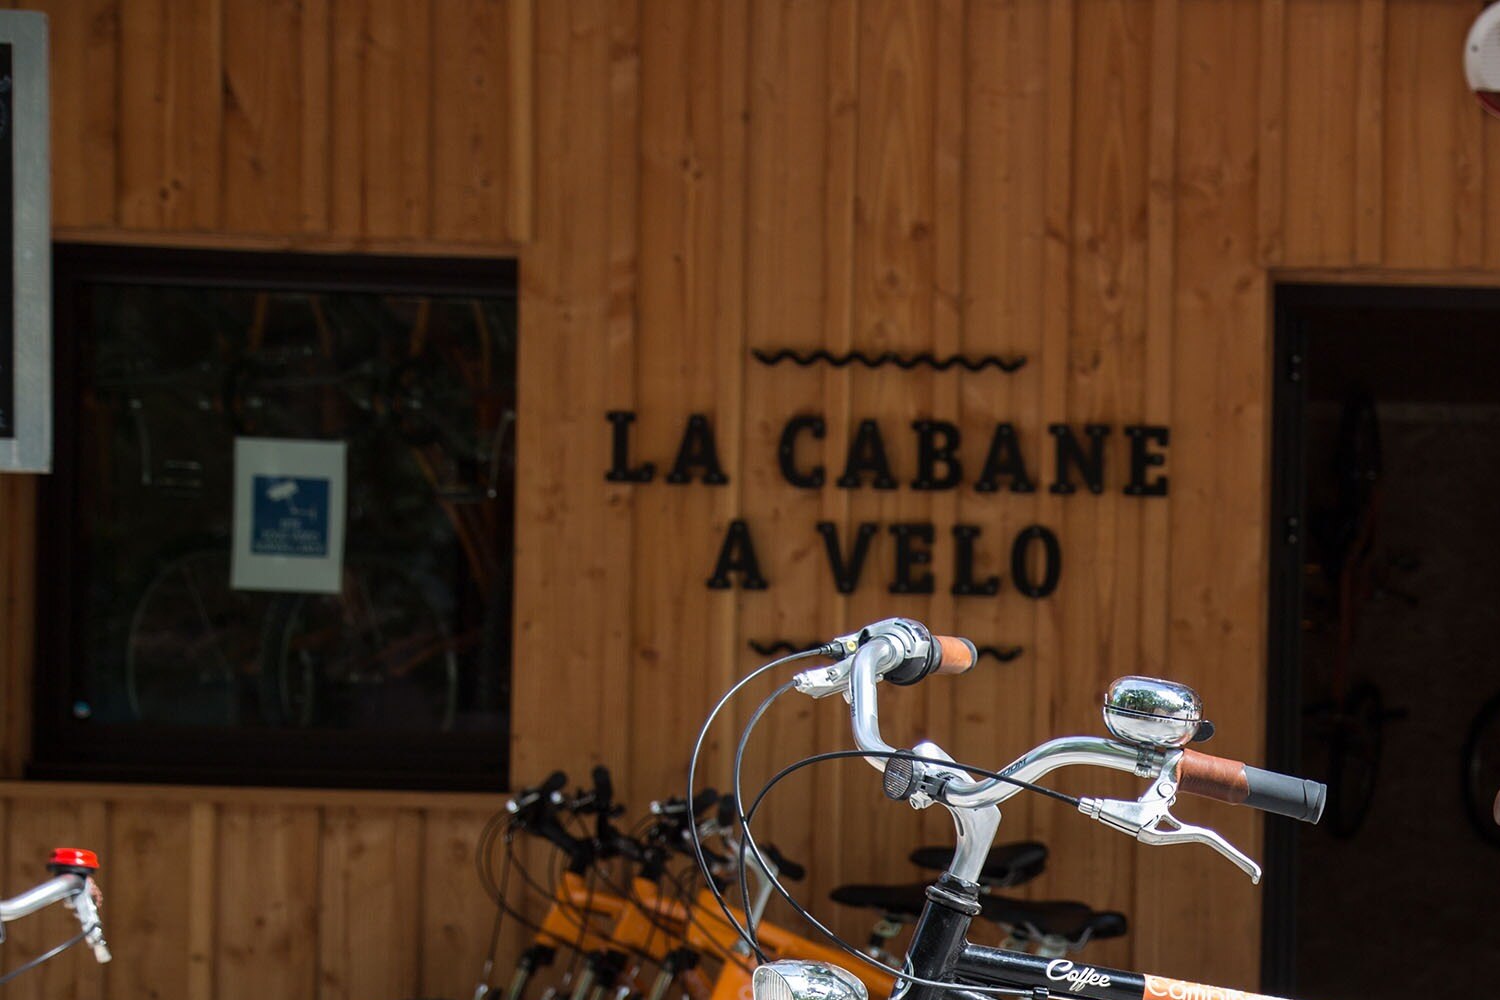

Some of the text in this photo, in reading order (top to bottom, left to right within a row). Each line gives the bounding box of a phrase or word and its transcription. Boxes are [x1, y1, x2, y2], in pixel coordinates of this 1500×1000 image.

[605, 411, 1170, 497] LA CABANE
[706, 519, 1063, 599] A VELO
[1046, 958, 1111, 992] Coffee
